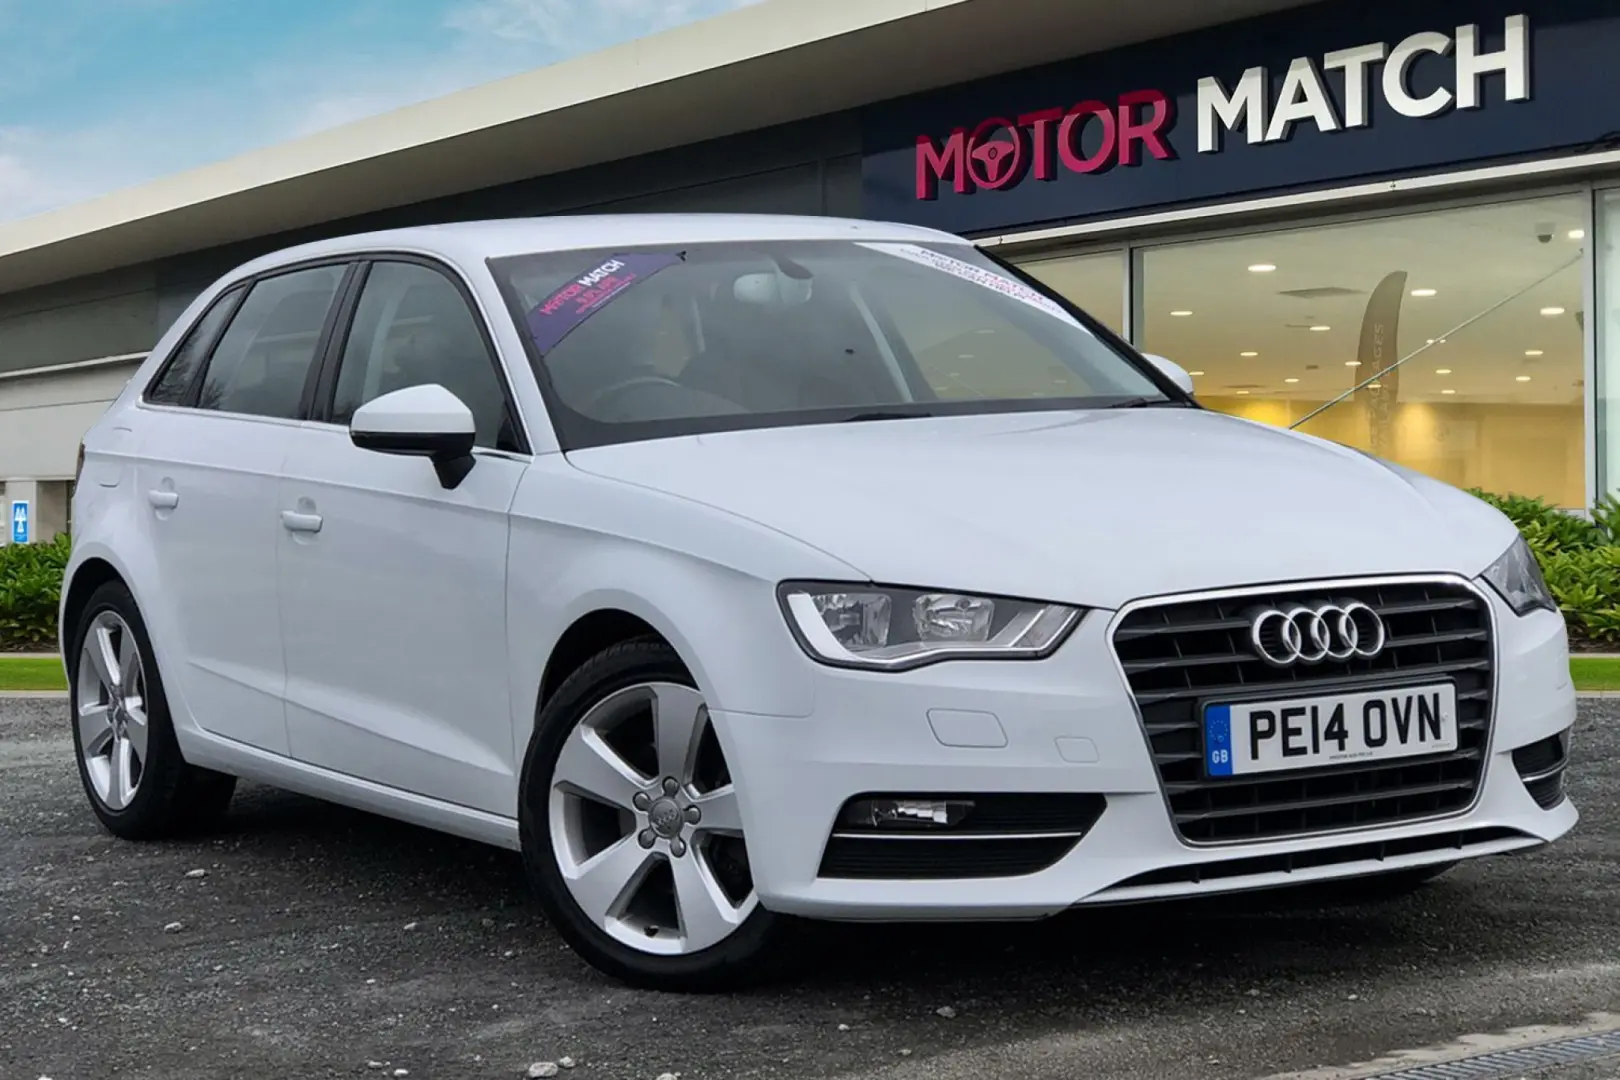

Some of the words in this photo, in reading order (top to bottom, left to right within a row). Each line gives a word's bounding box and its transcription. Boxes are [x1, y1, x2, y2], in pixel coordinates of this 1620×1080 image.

[915, 88, 1179, 200] MOTOR
[1197, 13, 1530, 153] MATCH
[577, 259, 625, 287] MATCH
[1249, 703, 1348, 761] PE14
[1363, 692, 1442, 748] OVN
[1212, 750, 1229, 764] GB
